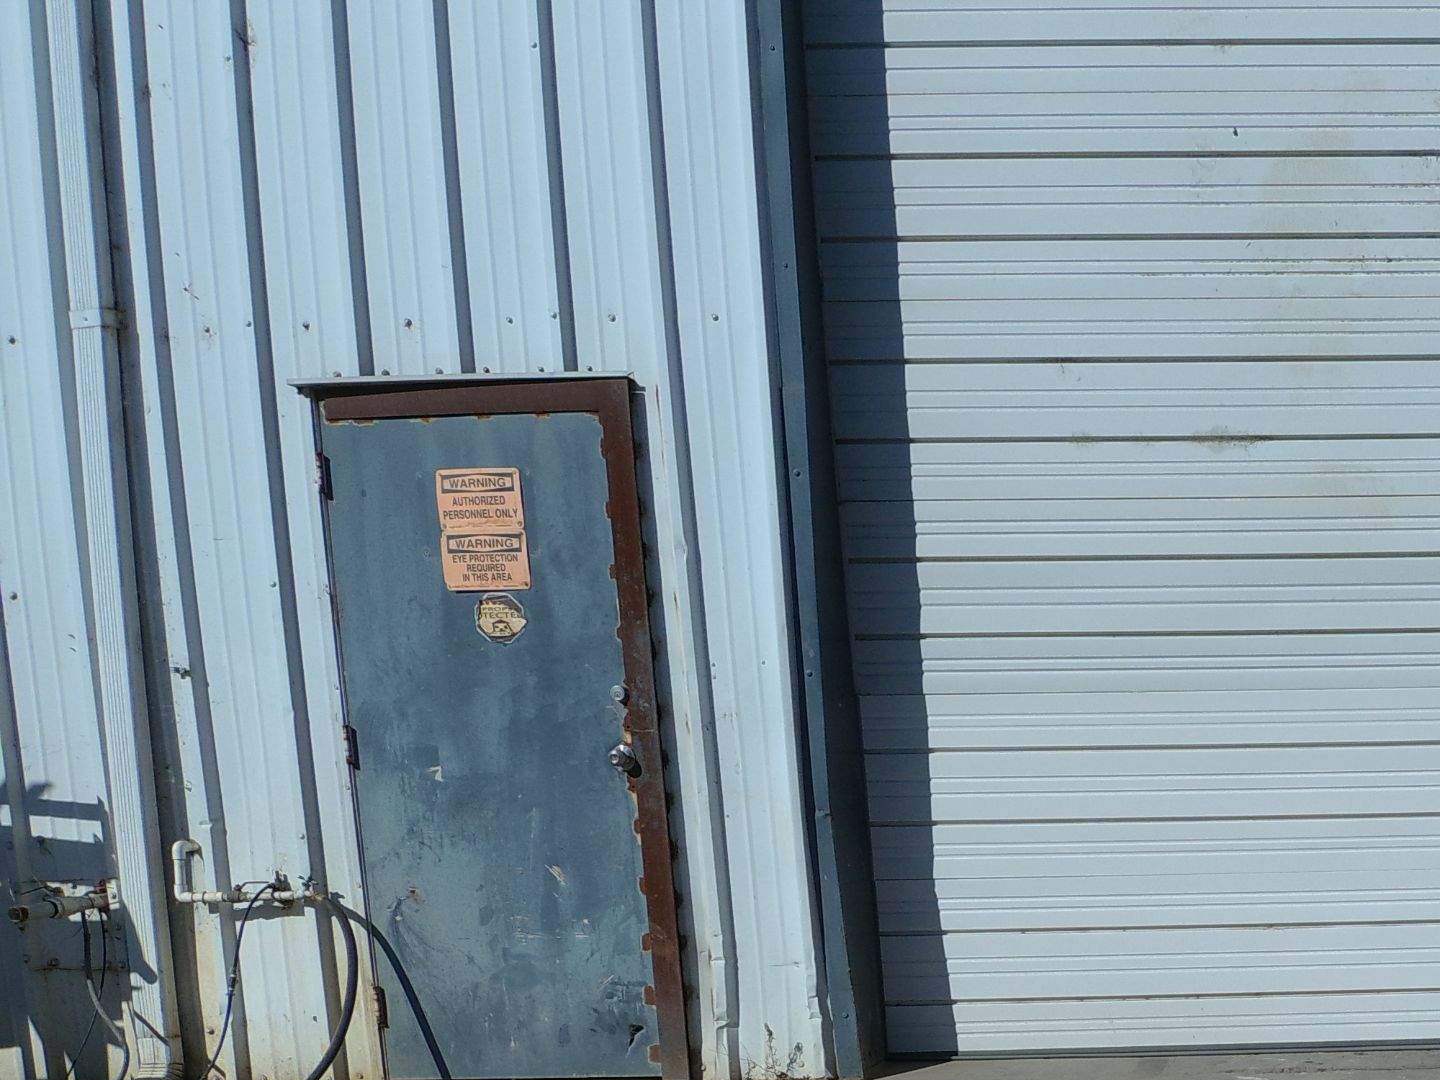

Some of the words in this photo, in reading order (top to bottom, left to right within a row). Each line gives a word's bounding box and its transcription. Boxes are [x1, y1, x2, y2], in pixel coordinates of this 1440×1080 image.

[449, 477, 506, 489] WARNING
[452, 495, 505, 507] AUTHORIZED
[443, 508, 493, 520] PERSONNEL
[495, 507, 518, 519] ONLY
[456, 538, 514, 549] WARNING
[452, 554, 467, 563] EYE
[469, 553, 519, 563] PROTECTION
[466, 563, 506, 572] REQUIRED
[462, 572, 470, 582] IN
[471, 572, 489, 582] THIS
[491, 572, 512, 581] AREA
